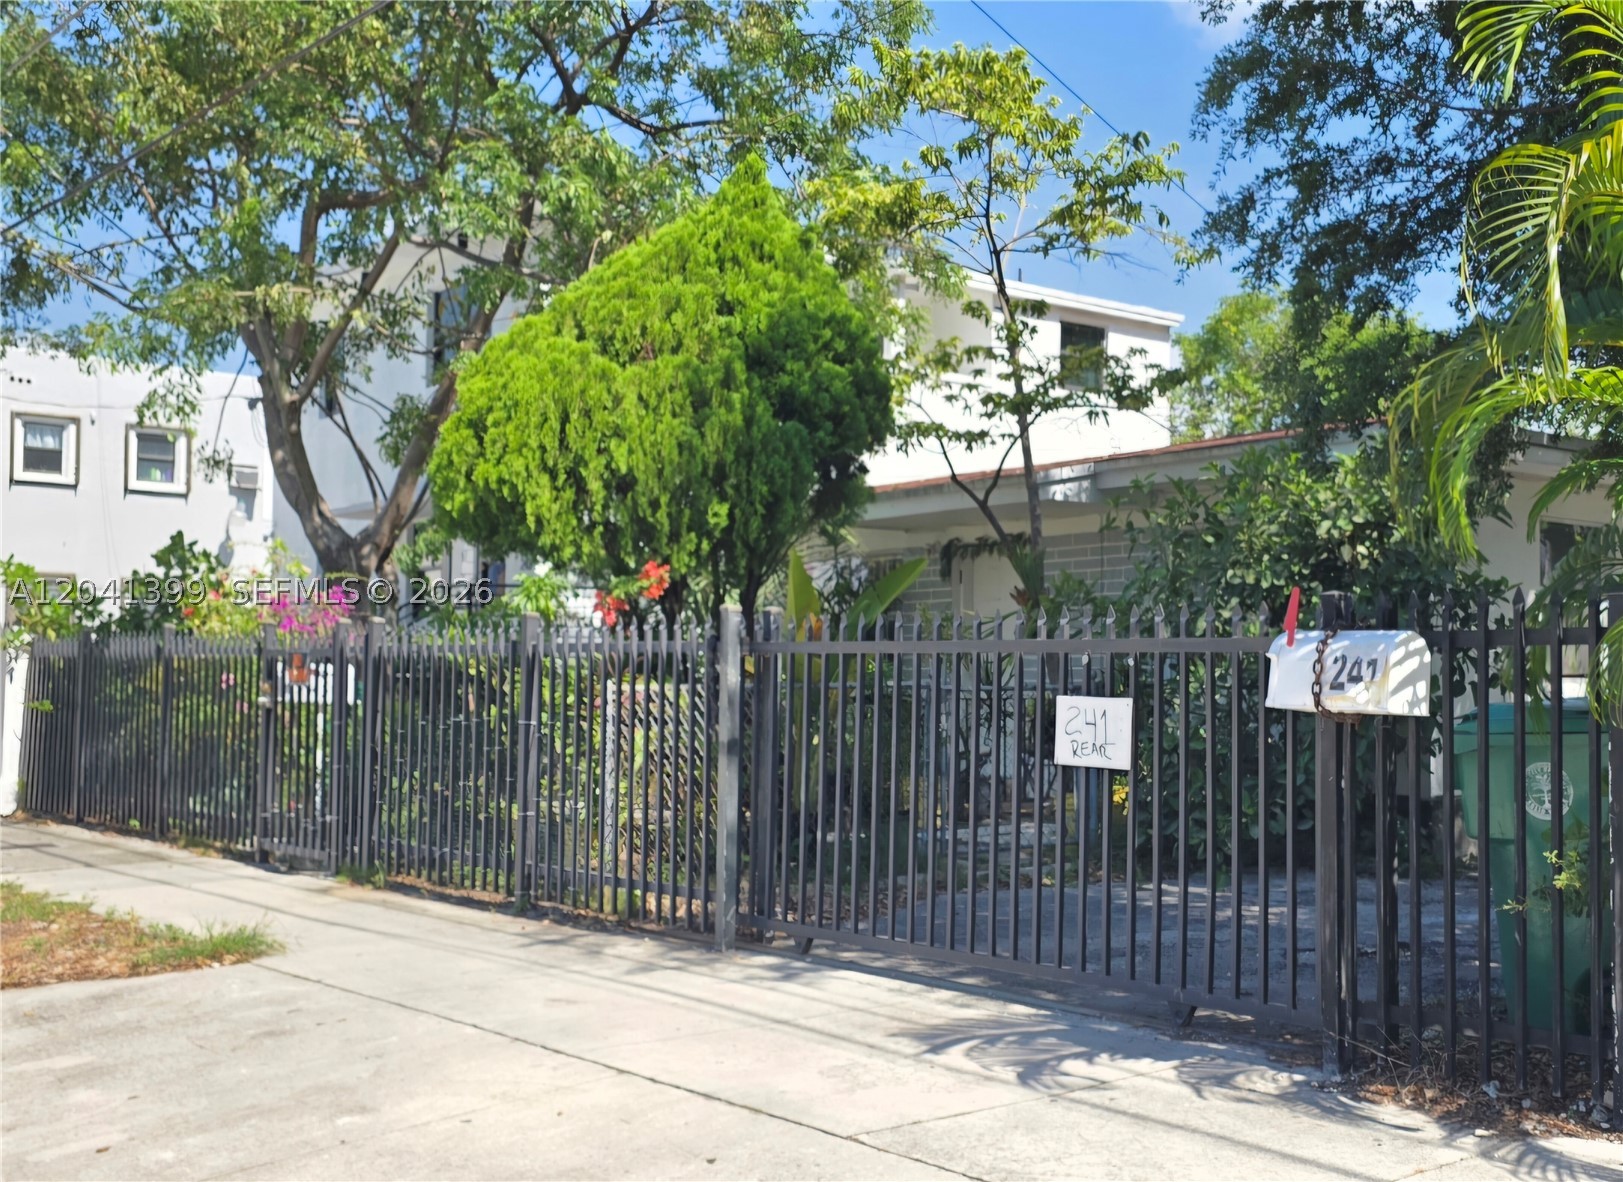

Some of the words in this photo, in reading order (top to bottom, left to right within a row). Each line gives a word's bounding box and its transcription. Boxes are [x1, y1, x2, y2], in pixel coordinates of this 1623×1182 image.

[1330, 654, 1379, 690] 241
[1065, 706, 1116, 745] 241
[1070, 740, 1112, 760] REAR
